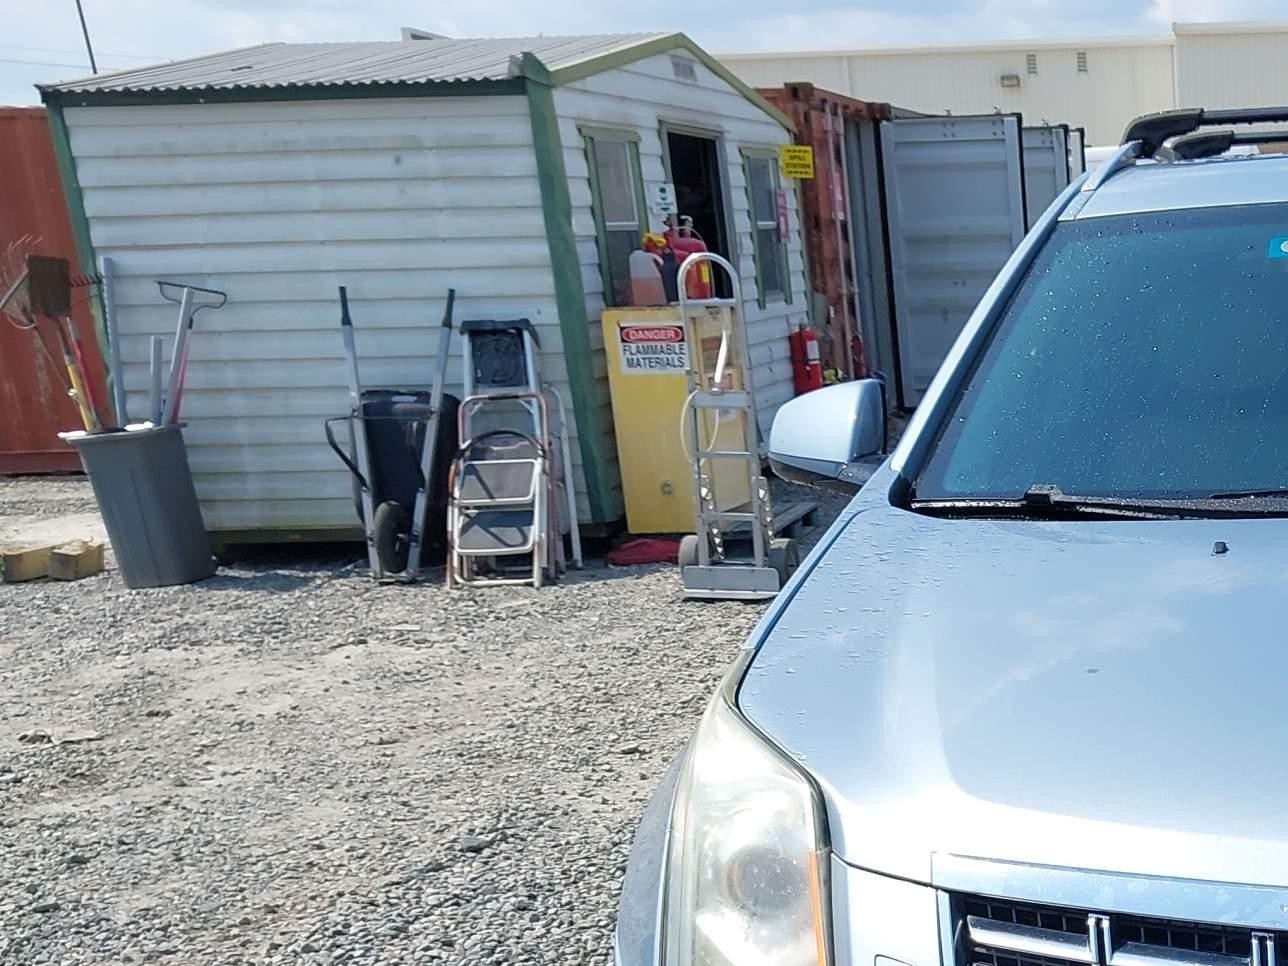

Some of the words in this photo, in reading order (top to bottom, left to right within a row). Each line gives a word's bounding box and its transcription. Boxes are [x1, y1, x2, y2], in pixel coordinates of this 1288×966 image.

[628, 329, 676, 340] DANGER
[623, 343, 686, 356] FLAMMABLE
[625, 356, 686, 369] MATERIALS
